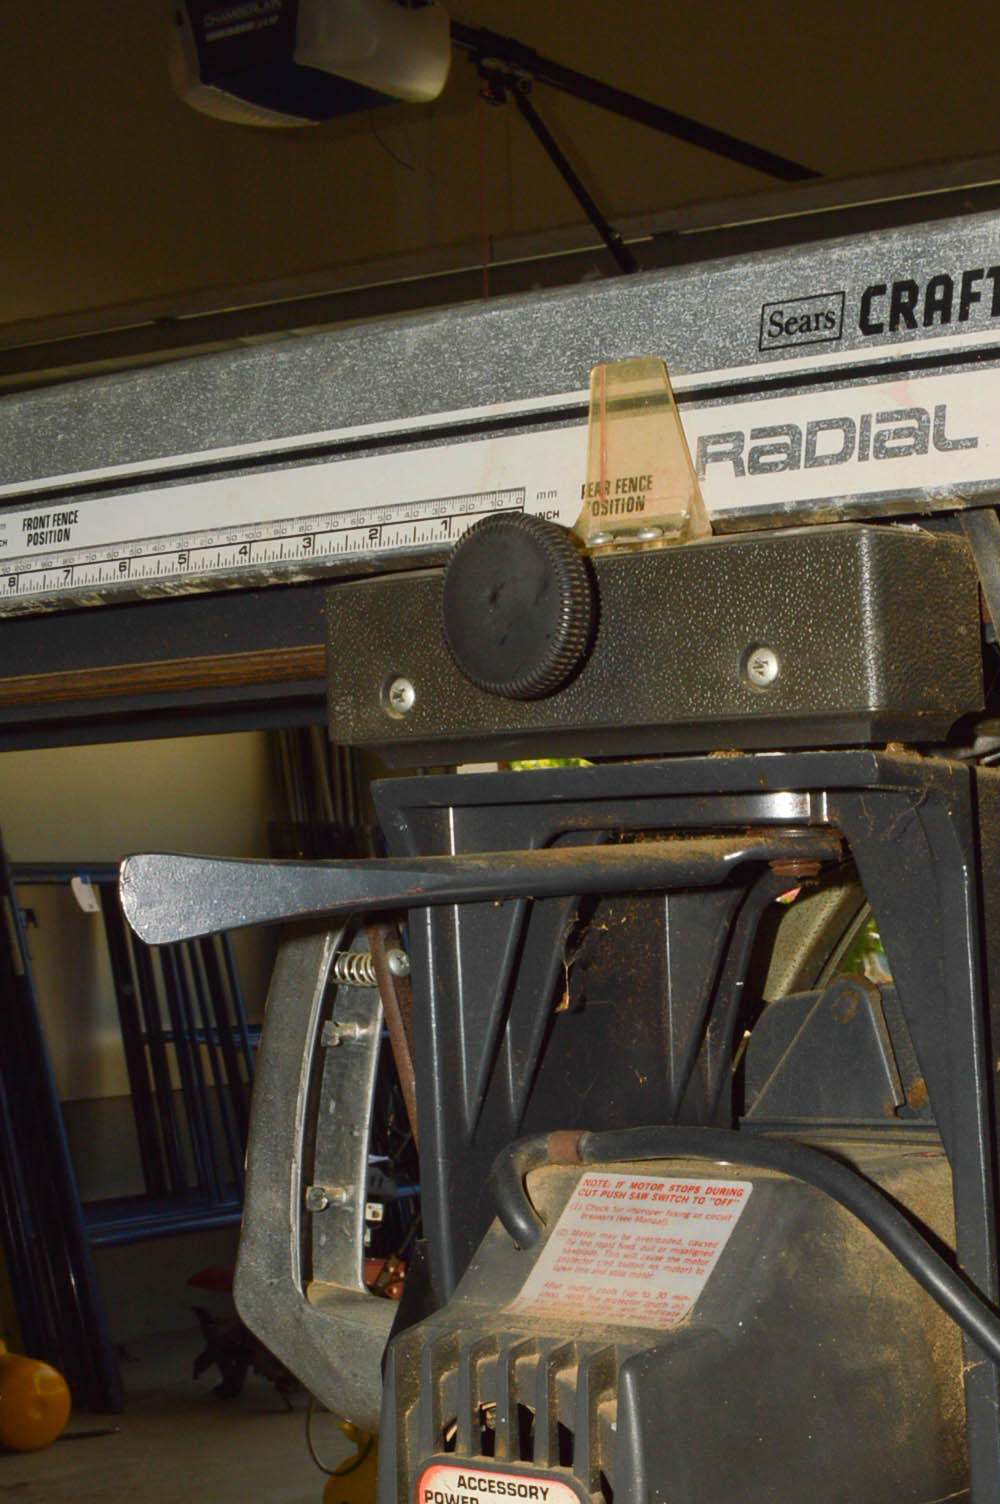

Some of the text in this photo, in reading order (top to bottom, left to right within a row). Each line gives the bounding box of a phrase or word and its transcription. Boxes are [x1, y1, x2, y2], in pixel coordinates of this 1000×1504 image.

[767, 309, 836, 339] Sears
[536, 489, 558, 500] mm
[615, 474, 653, 495] FENCE
[587, 495, 646, 517] OSITION
[22, 510, 79, 532] FRONT FENCE
[26, 527, 71, 547] POSITION
[8, 519, 448, 588] 8 7 6 5 4 3 2 1
[578, 1188, 598, 1197] CUT
[600, 1190, 626, 1200] PUSH
[629, 1192, 649, 1201] SAW
[651, 1193, 689, 1204] SWITCH
[692, 1197, 705, 1205] TO
[615, 1180, 625, 1188] IF
[630, 1181, 665, 1192] MOTOR
[669, 1183, 700, 1194] STOPS
[705, 1186, 745, 1197] DURING
[457, 1475, 549, 1501] ACCESSORY
